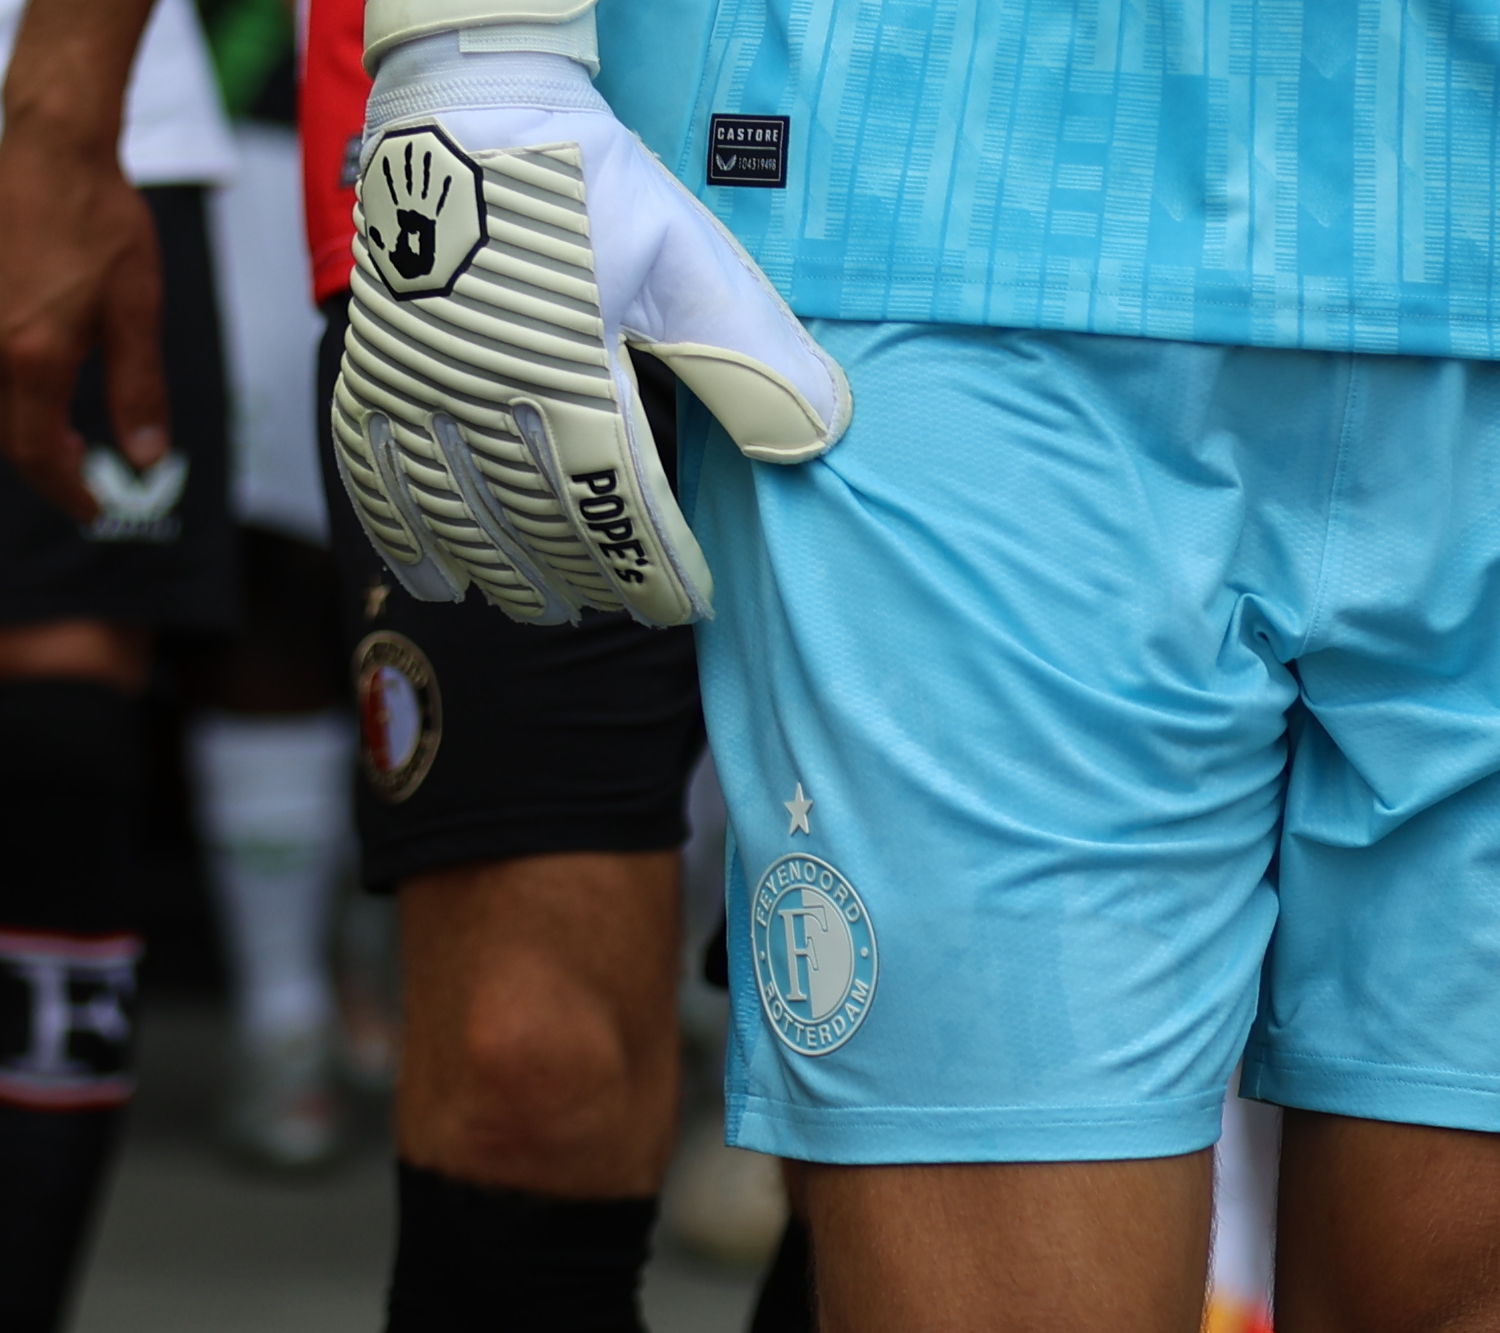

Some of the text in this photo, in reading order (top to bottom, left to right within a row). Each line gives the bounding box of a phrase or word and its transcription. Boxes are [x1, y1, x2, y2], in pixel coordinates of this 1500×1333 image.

[717, 127, 779, 142] CASTORE
[755, 860, 861, 928] FEYENOORD
[764, 978, 869, 1047] ROTTERDAM
